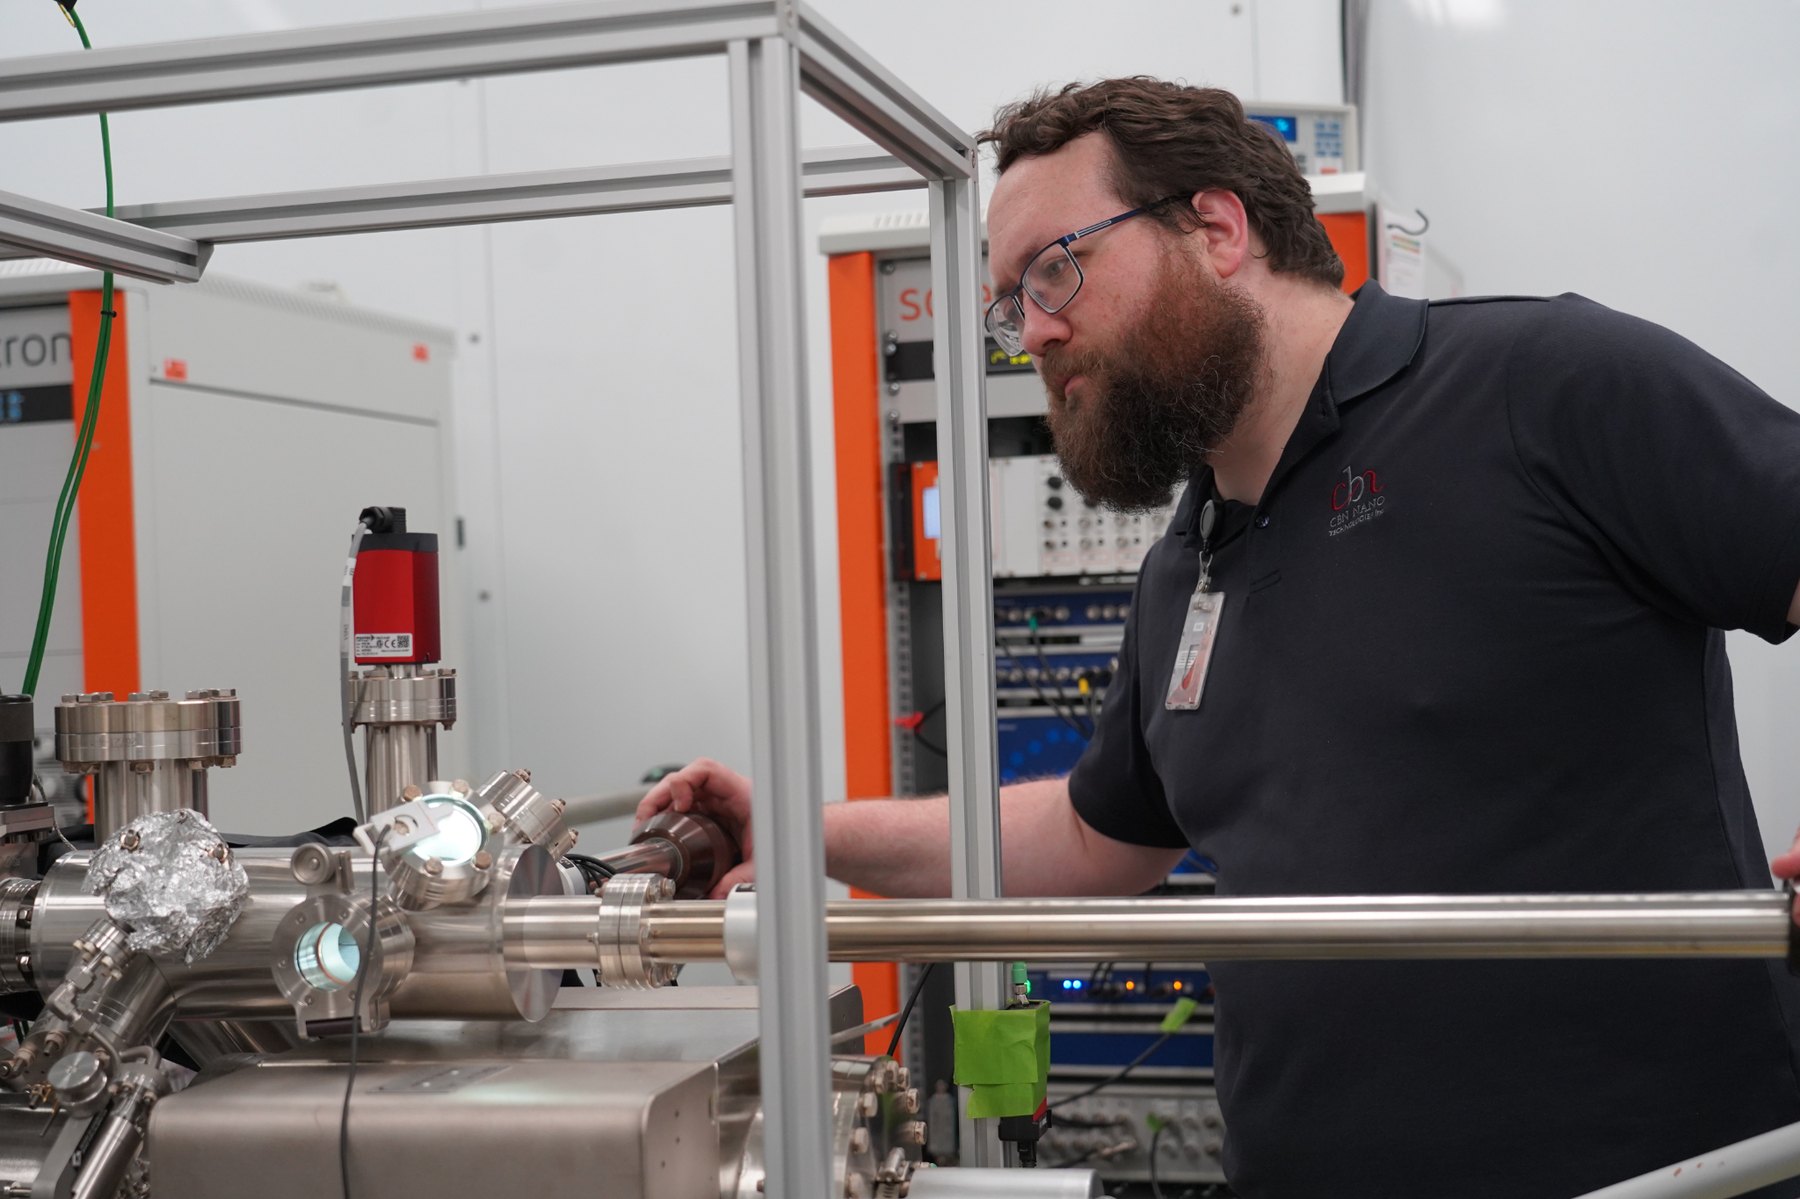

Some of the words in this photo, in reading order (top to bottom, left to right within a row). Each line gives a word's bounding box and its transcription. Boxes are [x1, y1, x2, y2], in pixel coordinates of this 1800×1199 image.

[0, 333, 73, 367] ron
[1329, 510, 1350, 528] CBN
[1352, 495, 1386, 518] NANO
